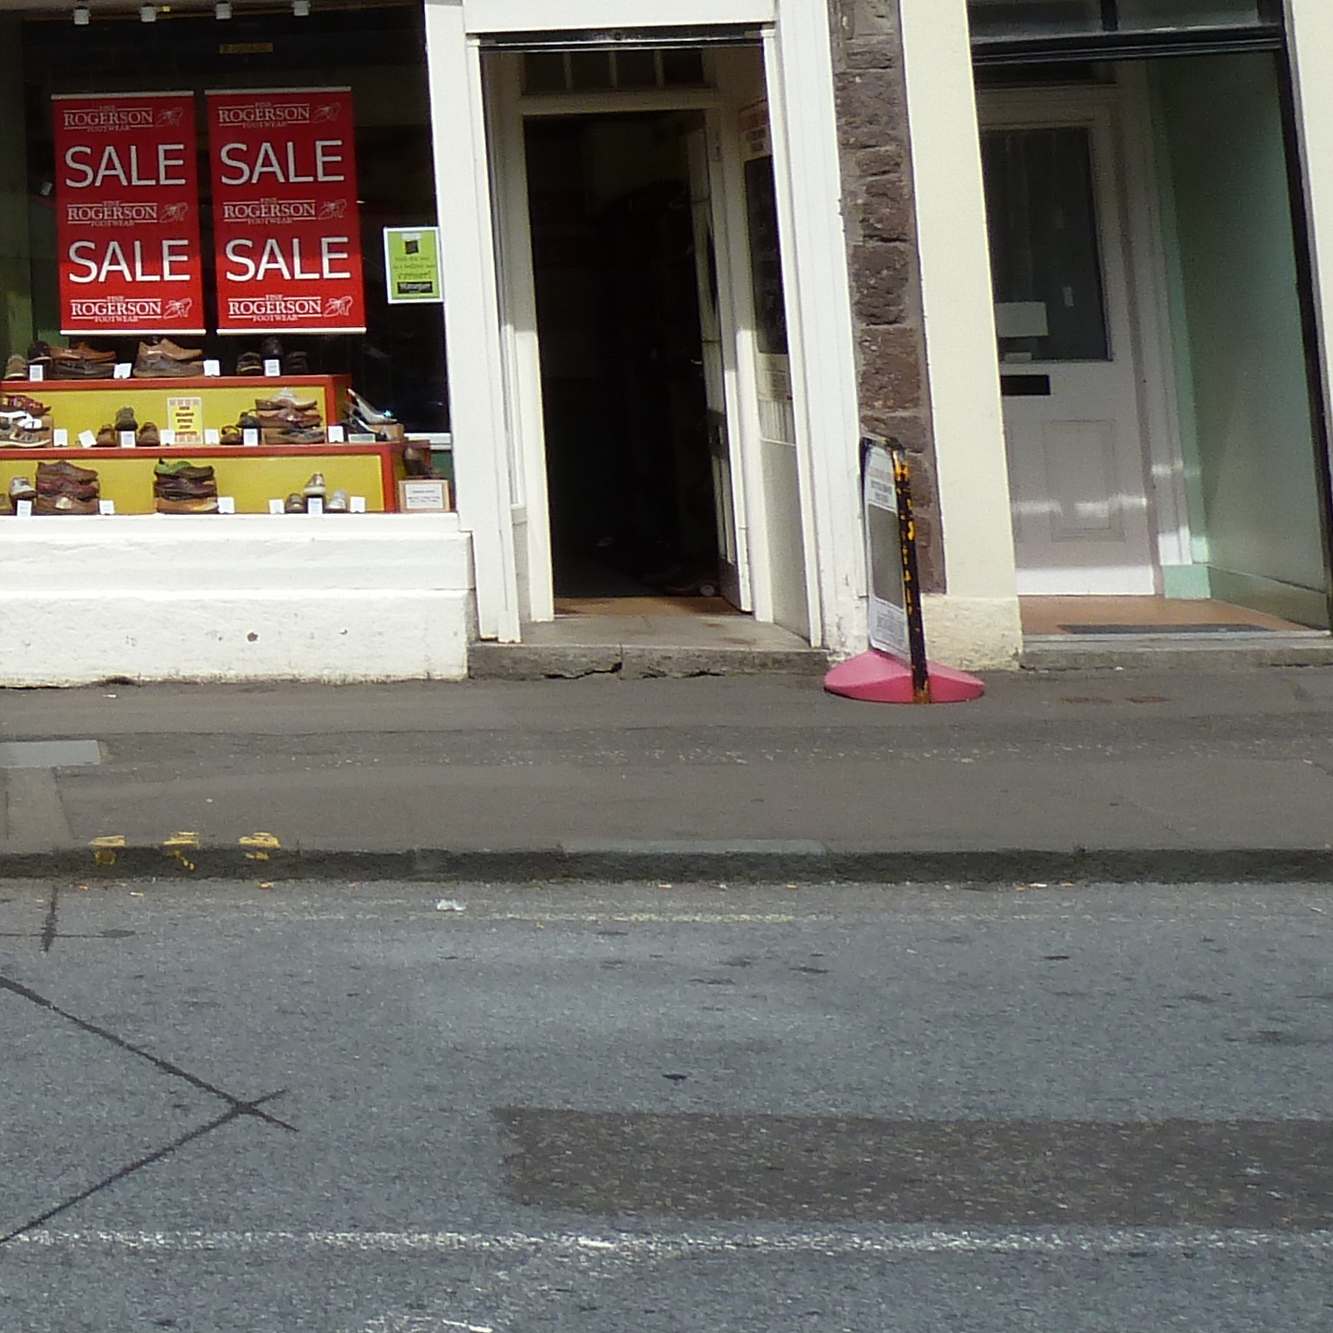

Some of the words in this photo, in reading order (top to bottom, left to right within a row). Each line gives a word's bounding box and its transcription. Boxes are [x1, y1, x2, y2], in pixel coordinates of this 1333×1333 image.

[63, 108, 154, 126] ROGERSON
[218, 105, 310, 123] ROGERSON
[64, 143, 186, 188] SALE
[220, 140, 345, 185] SALE
[67, 203, 158, 221] ROGERSON
[223, 200, 316, 219] ROGERSON
[68, 239, 191, 283] SALE
[225, 236, 352, 281] SALE
[70, 299, 162, 317] ROGERSON
[228, 297, 321, 315] ROGERSON
